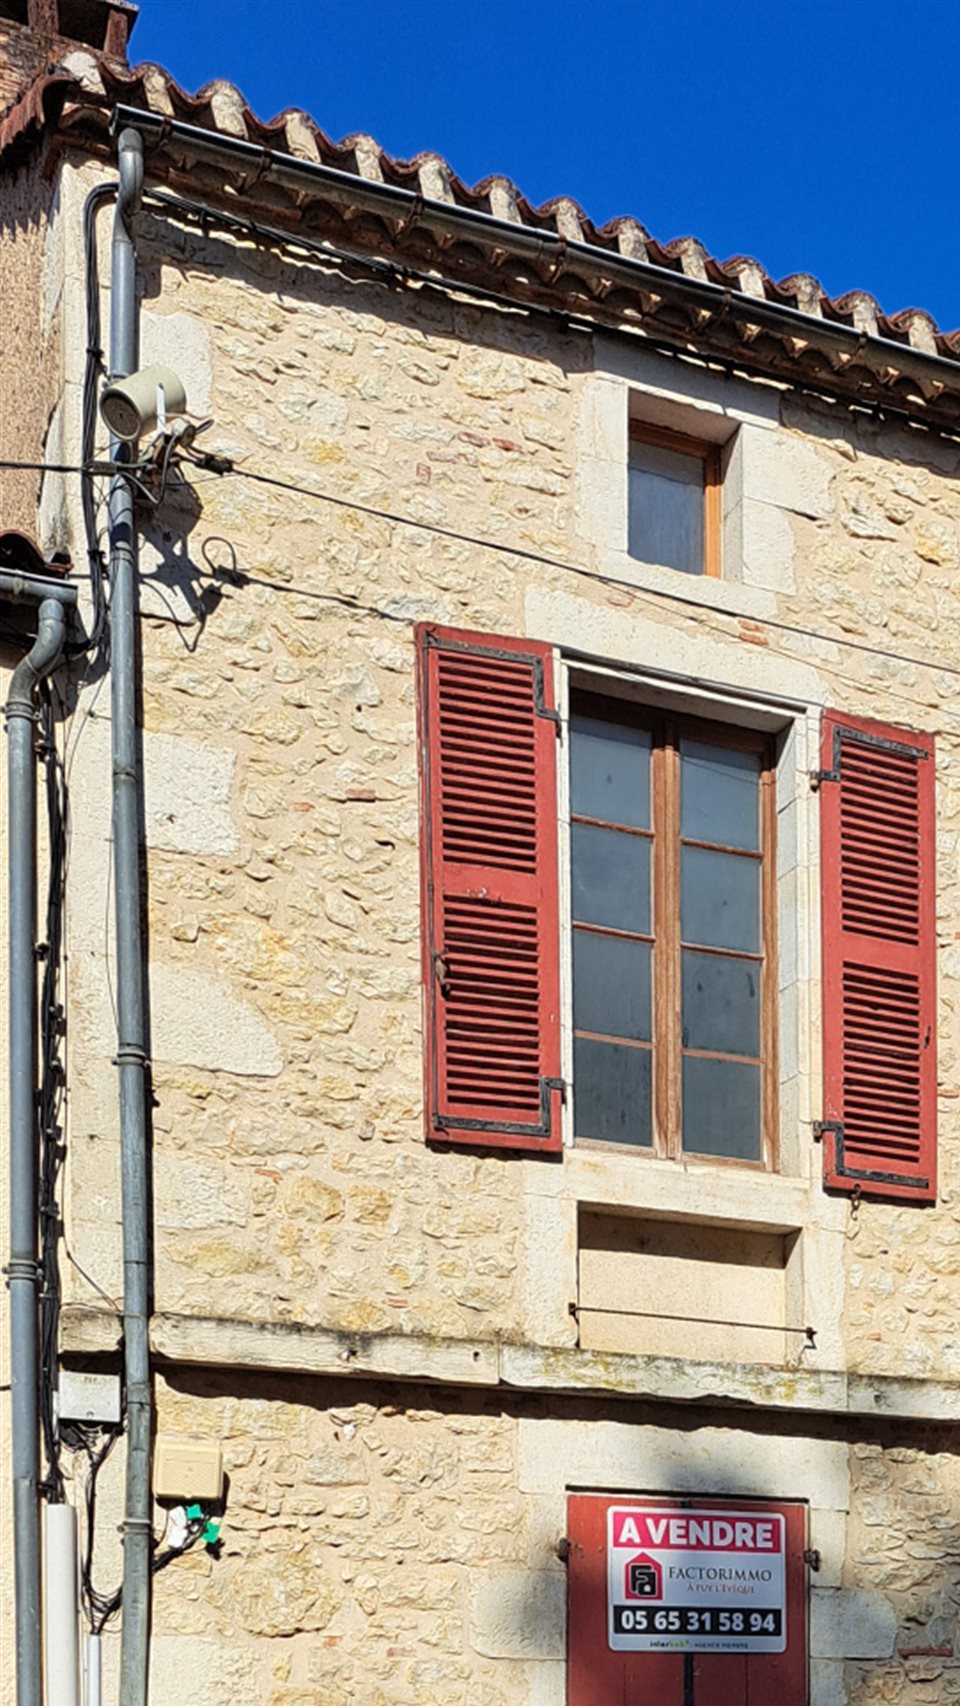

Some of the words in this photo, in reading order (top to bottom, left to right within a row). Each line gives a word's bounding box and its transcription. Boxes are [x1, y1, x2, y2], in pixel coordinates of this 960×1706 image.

[619, 1517, 641, 1544] A
[645, 1518, 774, 1548] VENDRE
[668, 1566, 772, 1582] FACTORIMMO
[621, 1610, 648, 1630] 05
[654, 1611, 681, 1631] 65
[687, 1612, 711, 1631] 31
[719, 1612, 744, 1632] 58
[750, 1613, 775, 1632] 94
